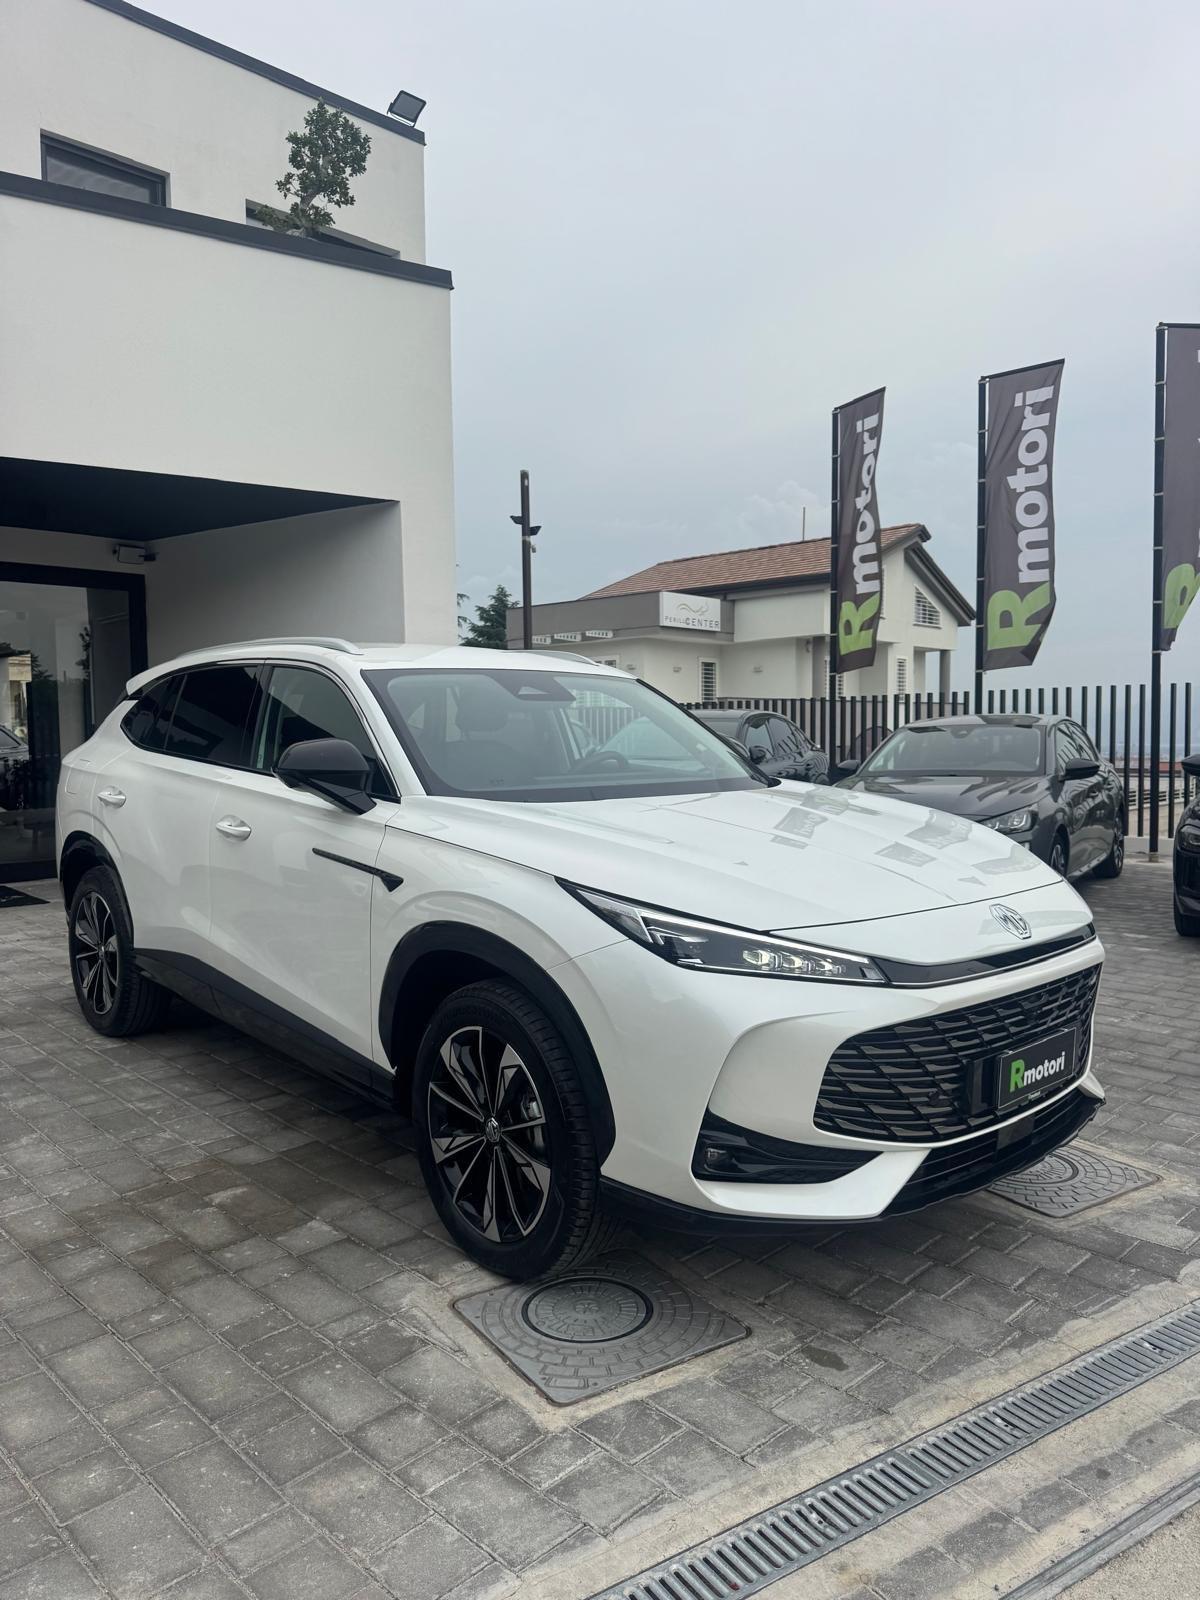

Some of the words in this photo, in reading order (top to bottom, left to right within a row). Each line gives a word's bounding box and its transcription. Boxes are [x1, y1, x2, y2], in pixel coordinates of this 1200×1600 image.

[838, 412, 880, 656] Rmotori
[987, 385, 1054, 650] Rmotori
[1010, 1051, 1065, 1093] Rmotori
